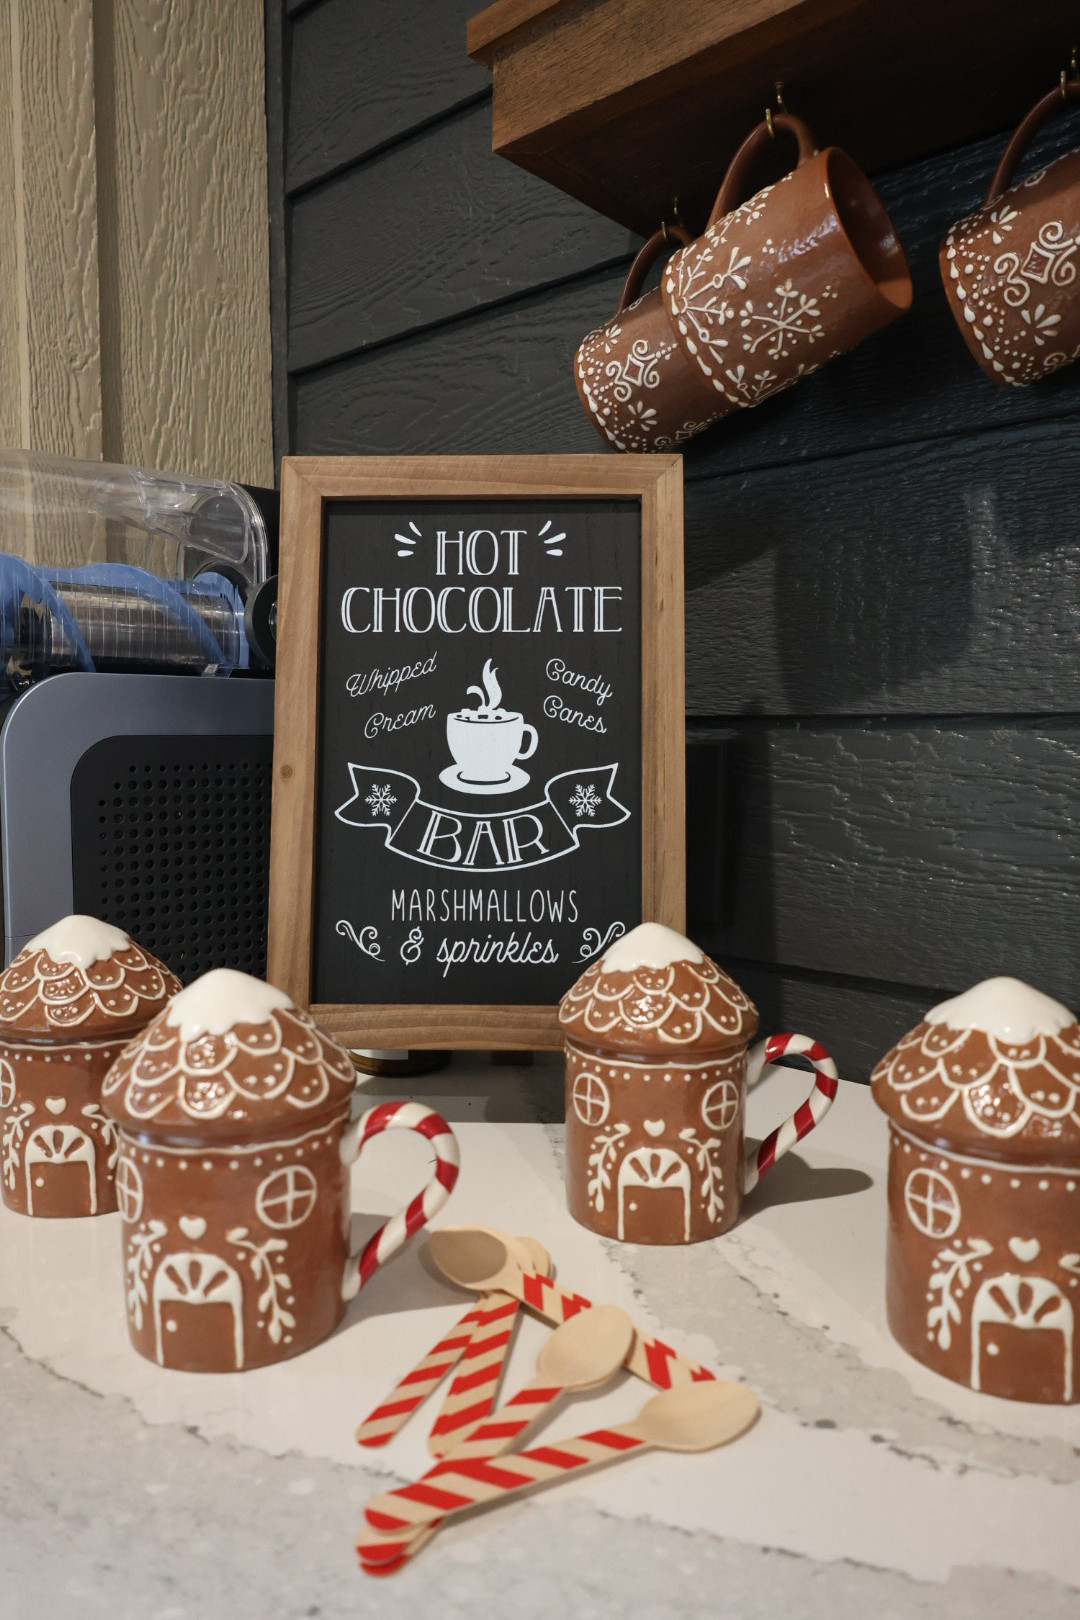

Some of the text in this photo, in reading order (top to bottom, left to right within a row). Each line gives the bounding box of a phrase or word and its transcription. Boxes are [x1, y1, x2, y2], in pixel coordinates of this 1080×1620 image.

[436, 530, 527, 576] HOT
[341, 587, 622, 633] CHOCOLATE
[346, 651, 438, 697] Whipped
[545, 658, 613, 706] Candy
[364, 704, 436, 738] Cream
[543, 694, 608, 734] Canes
[416, 810, 550, 866] BAR
[392, 889, 579, 922] MARSHMALLOWS
[400, 926, 560, 979] & sprinkles
